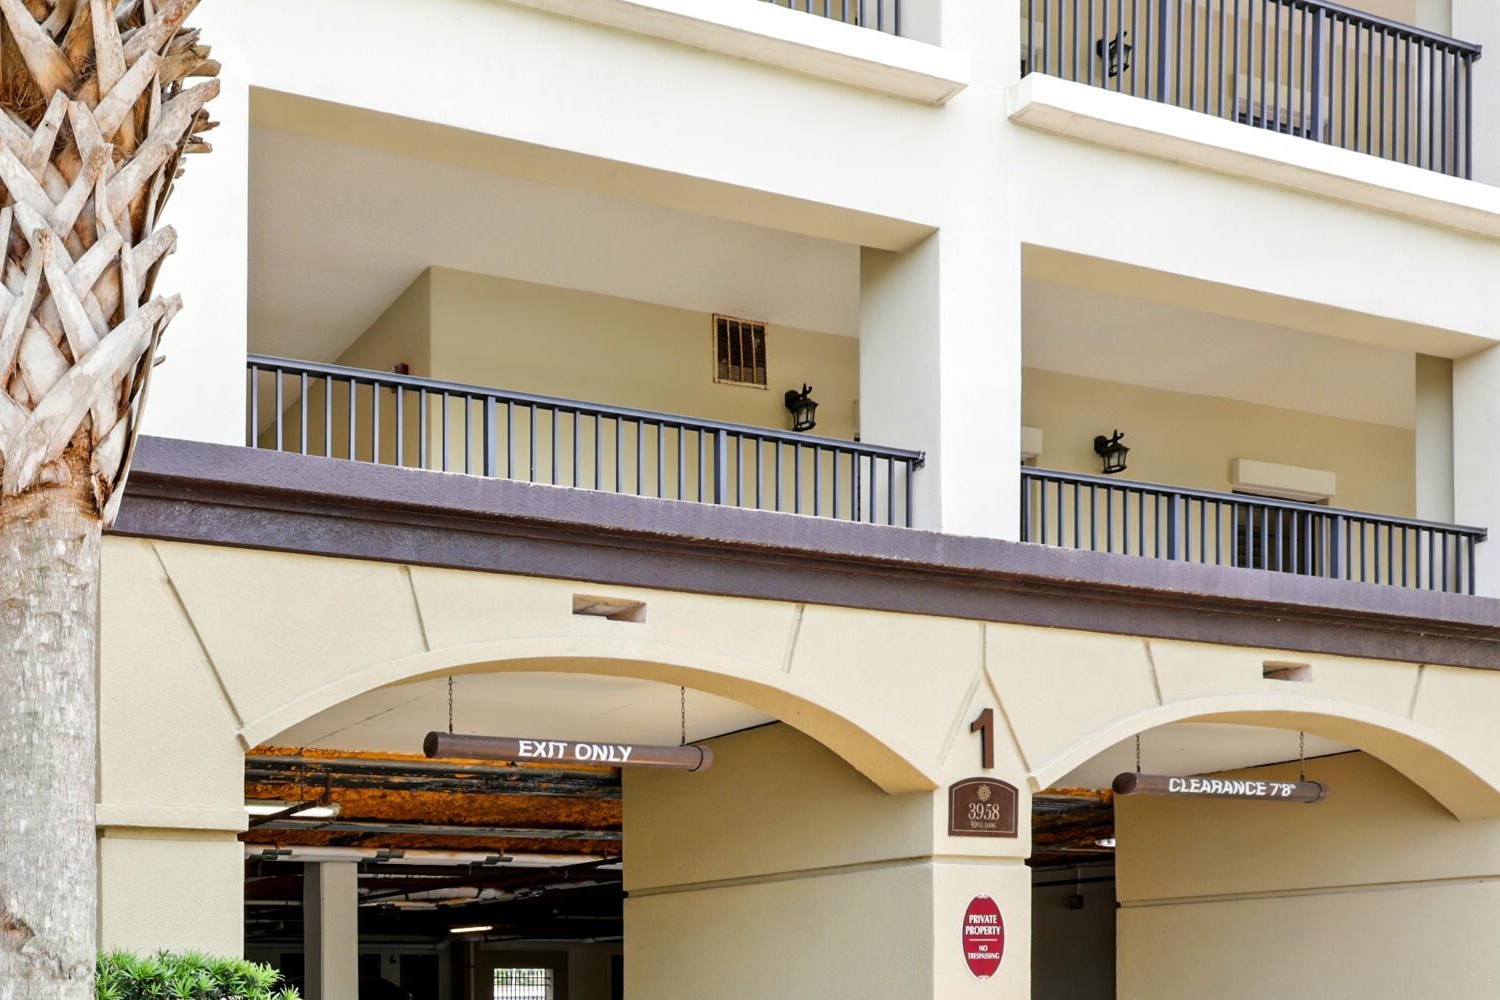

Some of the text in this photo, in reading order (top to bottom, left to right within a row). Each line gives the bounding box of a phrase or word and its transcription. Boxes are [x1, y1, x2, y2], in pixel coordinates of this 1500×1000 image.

[970, 707, 994, 769] 1
[518, 740, 632, 762] EXIT ONLY
[1168, 777, 1266, 796] CLEARANCE
[968, 802, 1000, 820] 3958
[968, 914, 997, 924] PRIVATE
[965, 925, 1001, 935] PROPERTY
[978, 944, 988, 952] NO
